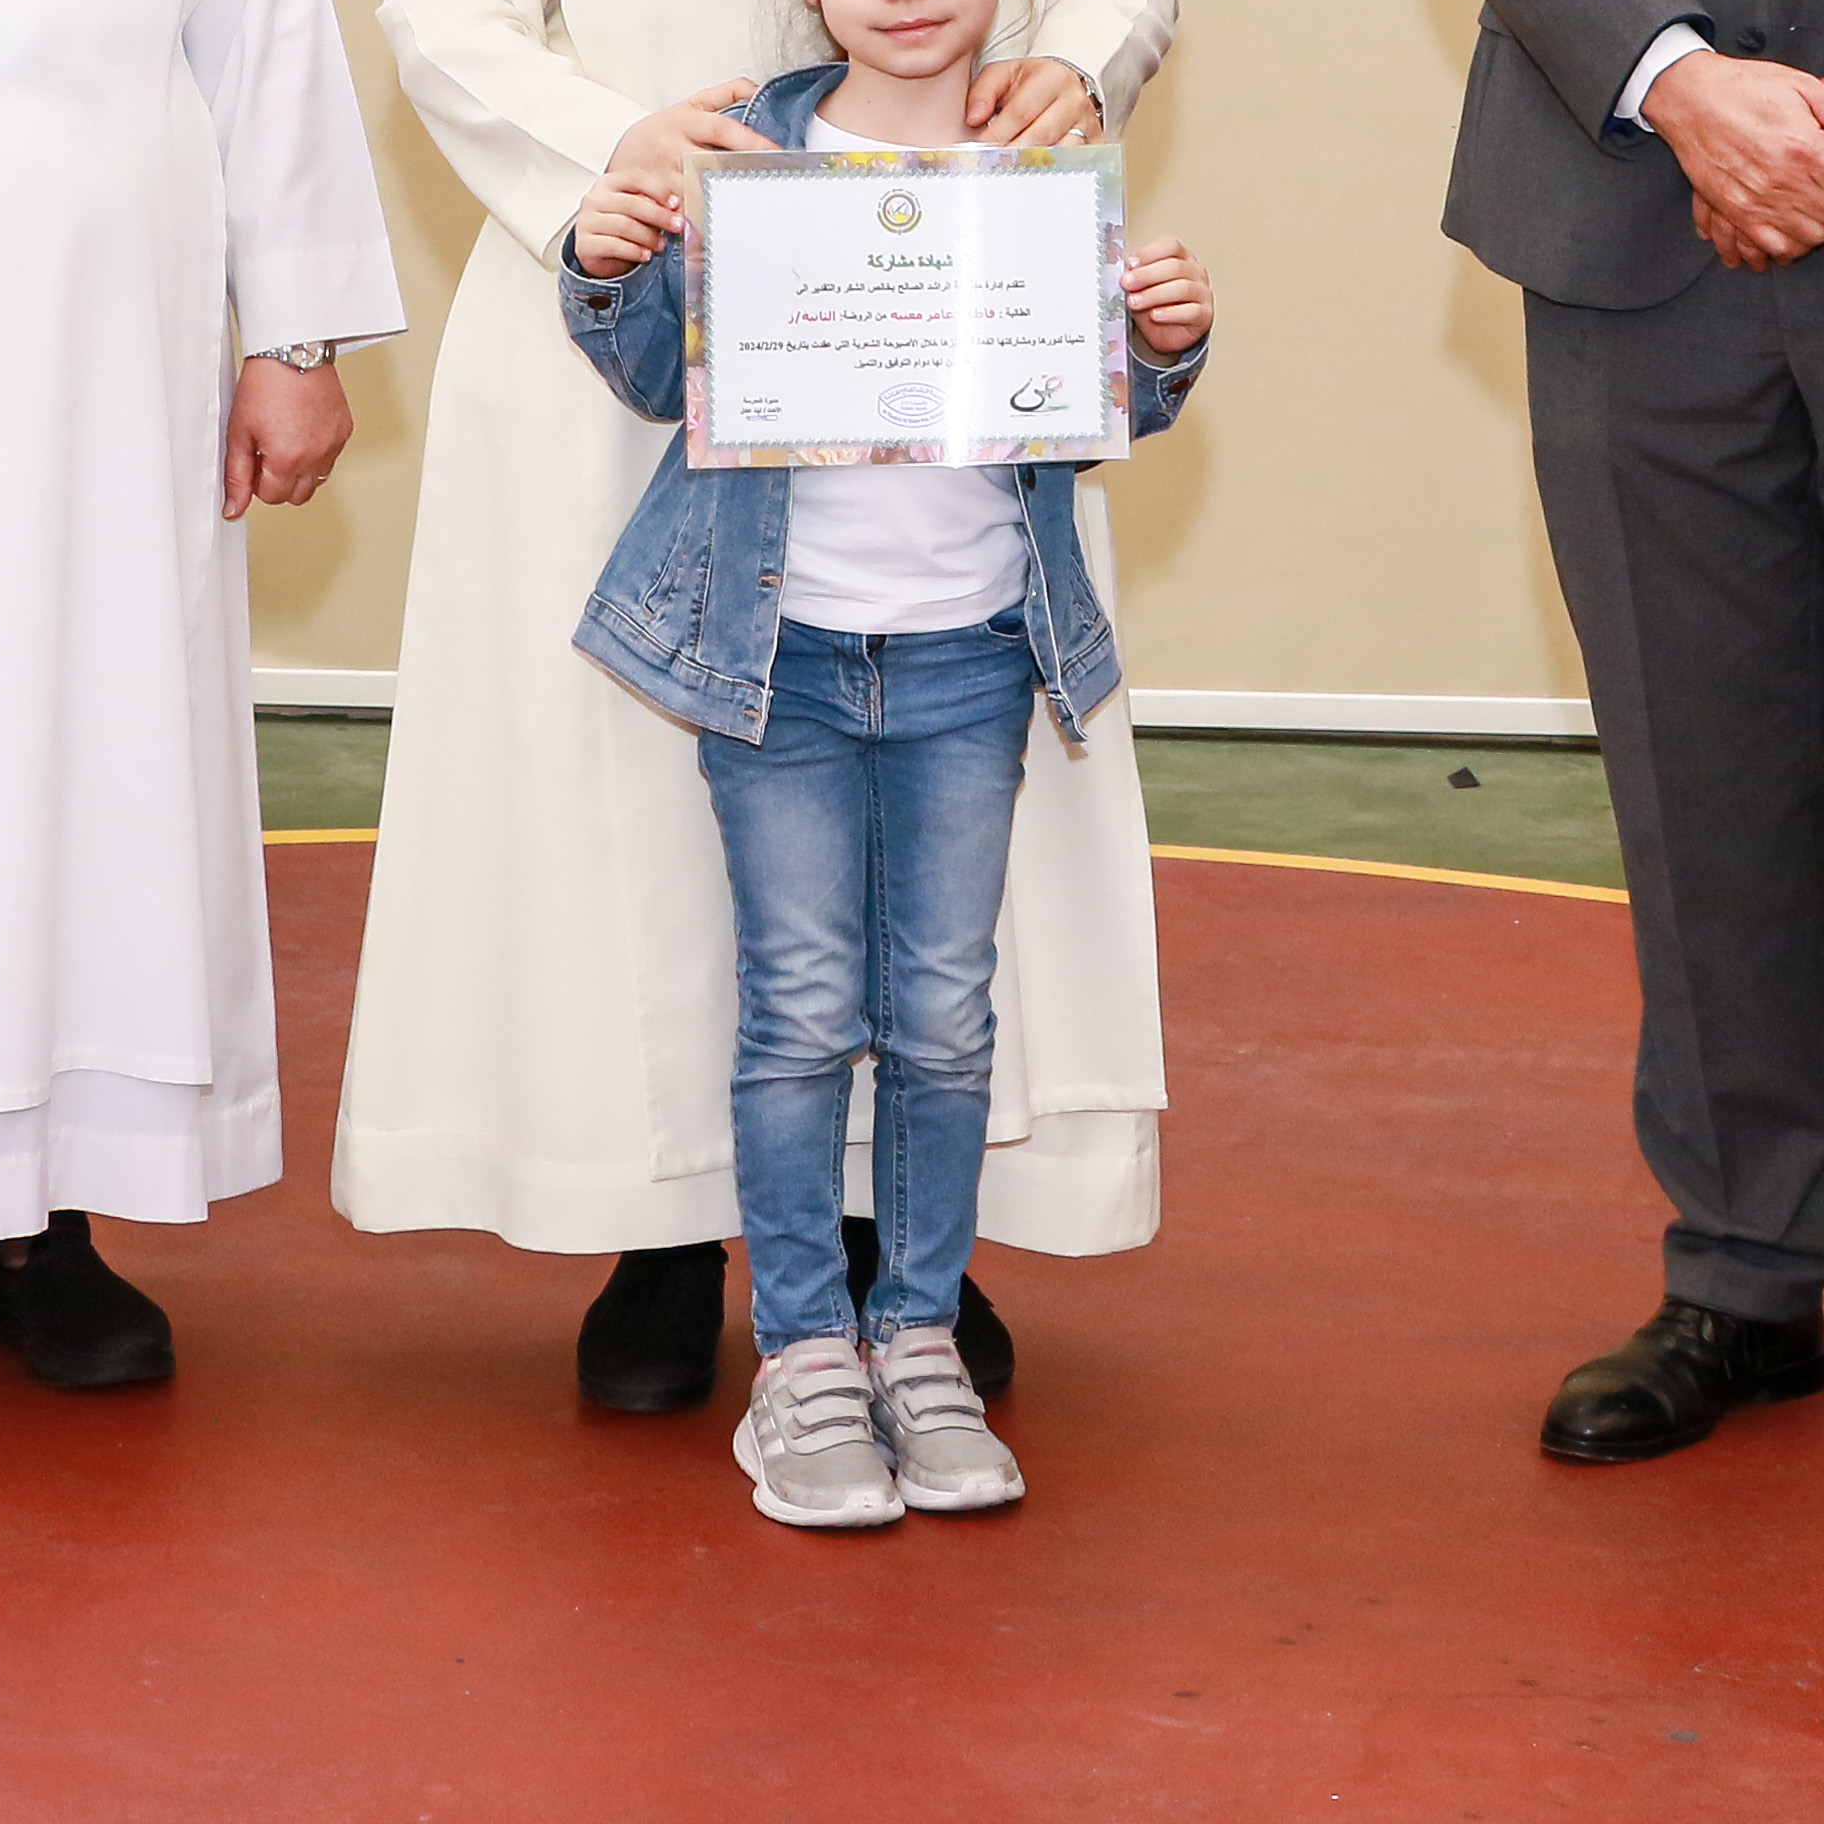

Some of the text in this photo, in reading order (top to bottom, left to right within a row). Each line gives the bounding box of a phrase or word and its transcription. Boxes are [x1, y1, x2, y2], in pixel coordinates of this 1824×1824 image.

[867, 254, 953, 272] شهادة مشاركة
[897, 282, 924, 294] الصالح
